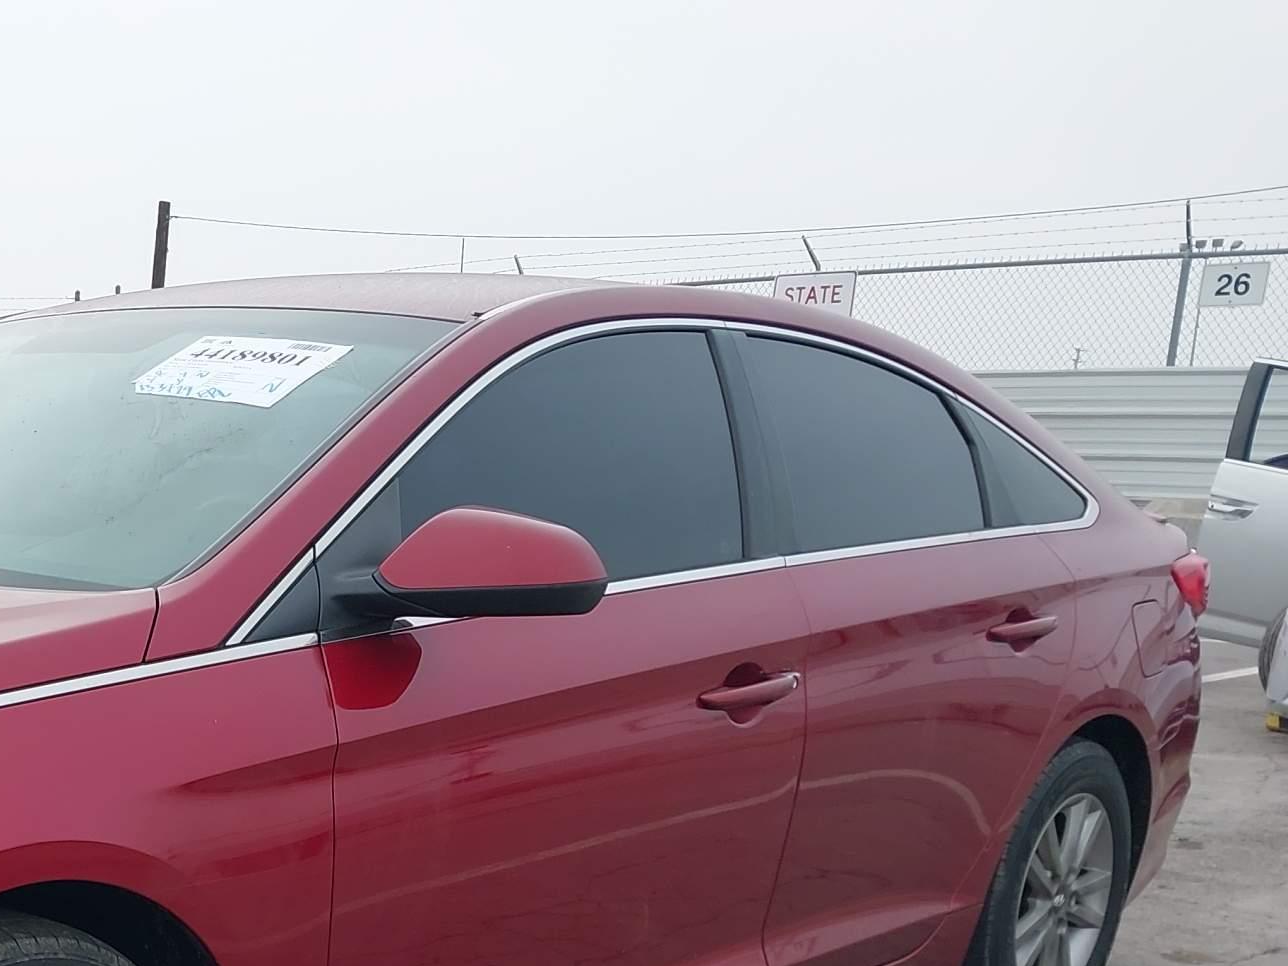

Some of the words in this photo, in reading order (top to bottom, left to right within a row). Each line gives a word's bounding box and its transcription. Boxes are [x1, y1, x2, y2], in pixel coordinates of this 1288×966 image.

[1215, 273, 1251, 296] 26
[785, 285, 843, 305] STATE
[190, 347, 313, 367] 44189801
